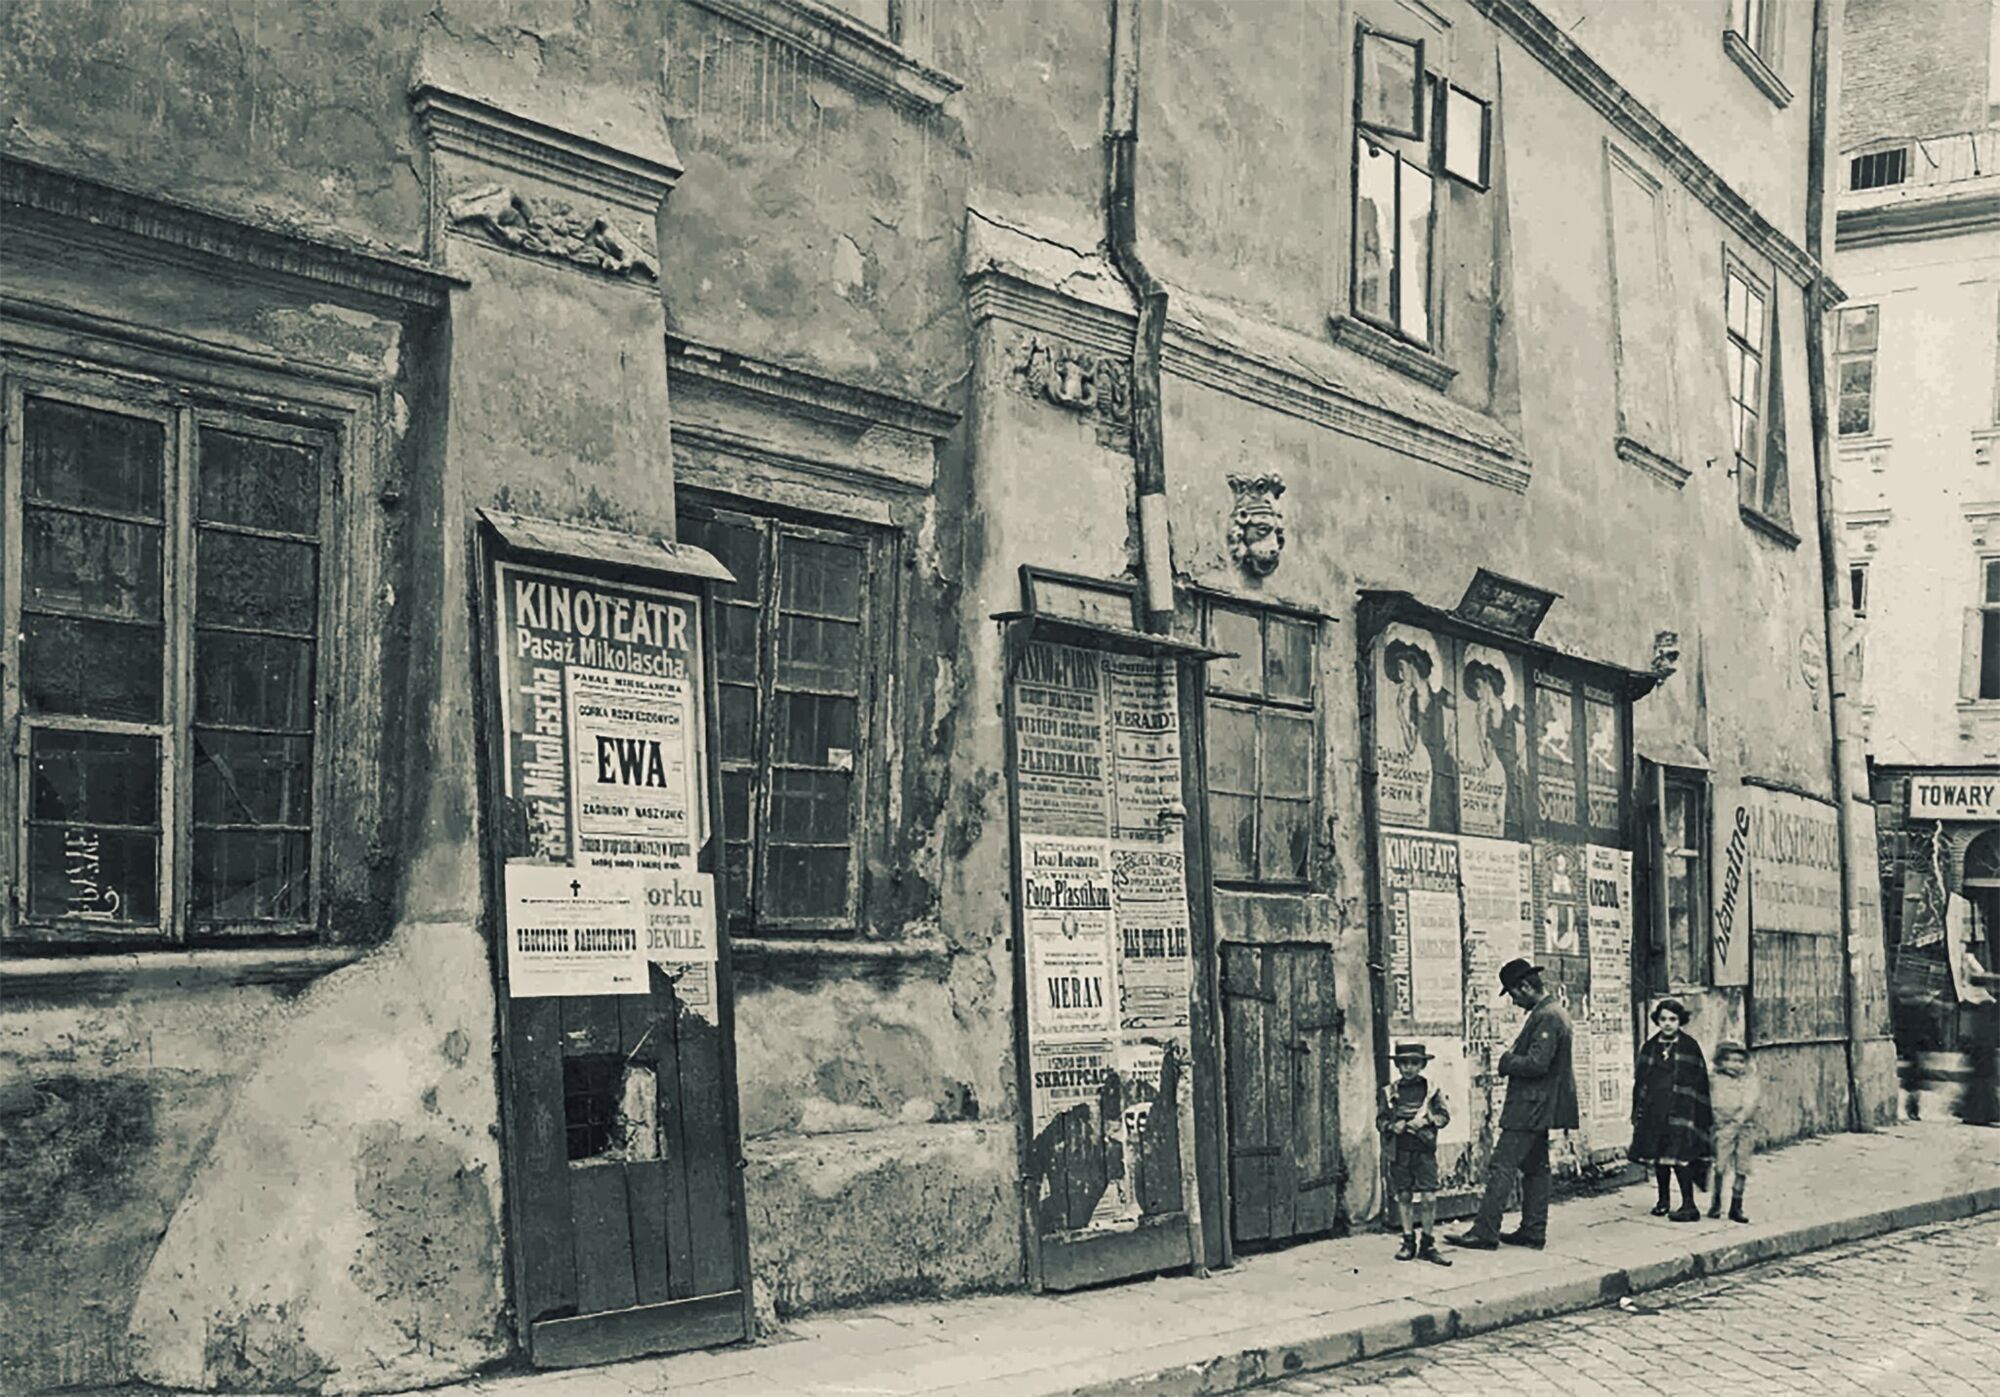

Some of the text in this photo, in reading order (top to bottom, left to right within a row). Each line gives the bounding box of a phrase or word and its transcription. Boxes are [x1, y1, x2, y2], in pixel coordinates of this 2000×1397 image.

[515, 580, 689, 652] KINOTEATR
[517, 627, 690, 680] Pasaż Mikolascha.
[520, 667, 565, 798] Mikolascha
[595, 735, 667, 789] EWA
[1918, 785, 1995, 807] TOWARY
[1384, 837, 1458, 874] KINOTEATR
[1047, 976, 1102, 1009] MERAN
